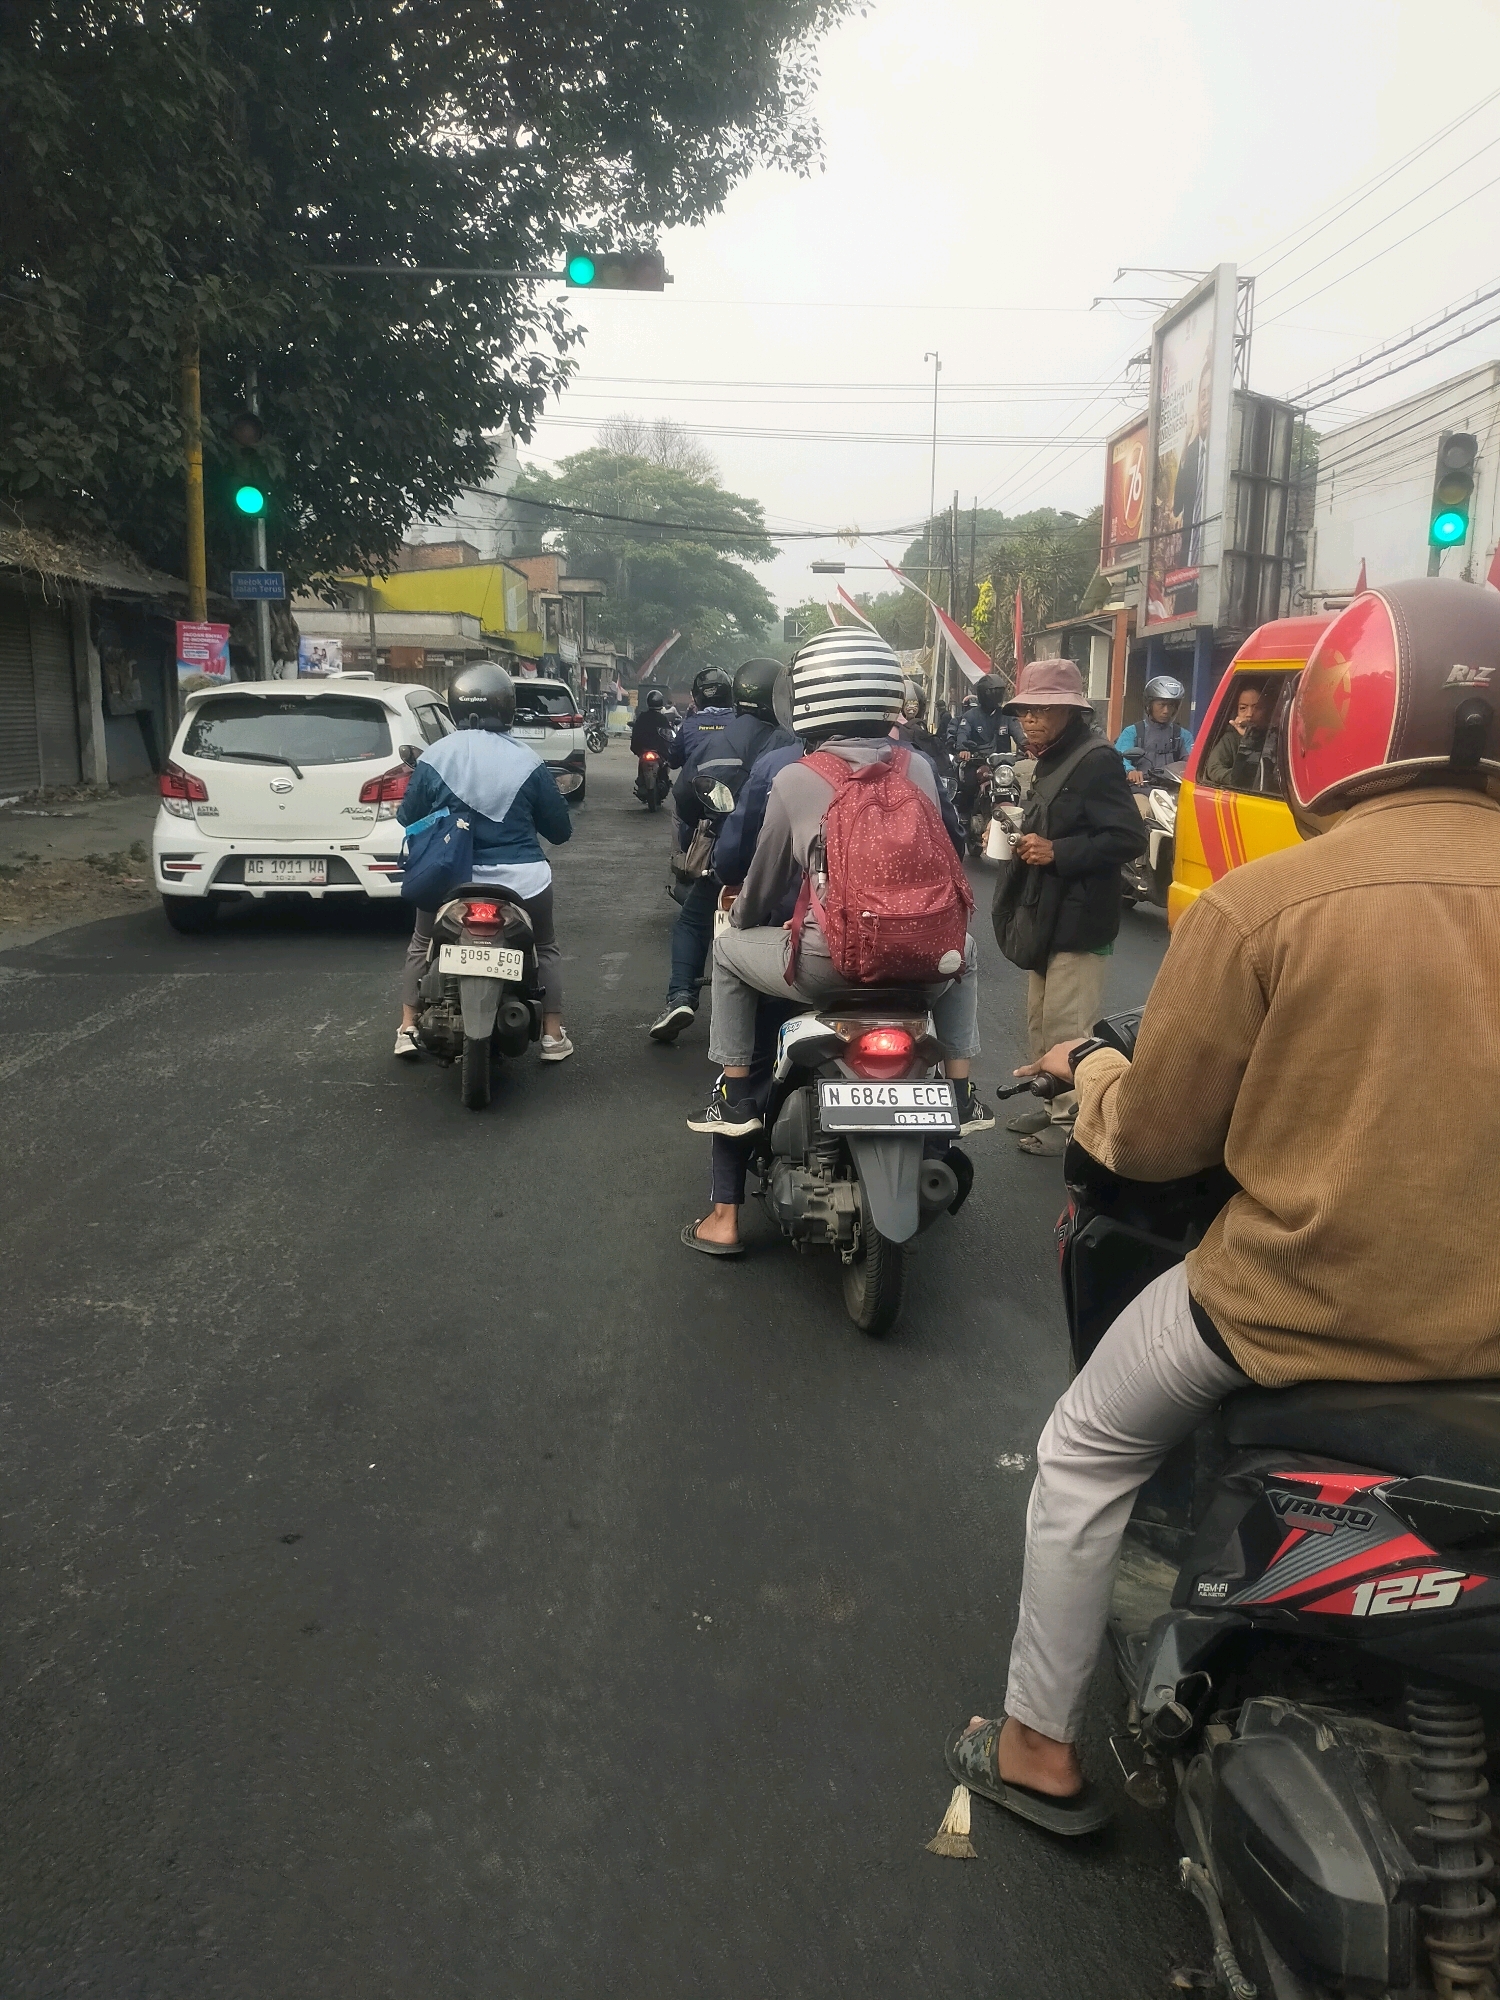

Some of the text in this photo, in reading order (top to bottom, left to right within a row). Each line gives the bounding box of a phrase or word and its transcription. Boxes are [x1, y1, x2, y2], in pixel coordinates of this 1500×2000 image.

[264, 578, 279, 586] Kiri
[248, 860, 325, 874] AG 1911 WA
[717, 912, 725, 925] N
[444, 947, 452, 958] N
[460, 949, 491, 961] 5095
[828, 1087, 950, 1106] N 6846 ECE
[1268, 1490, 1376, 1527] VARIO
[1351, 1570, 1467, 1616] 125
